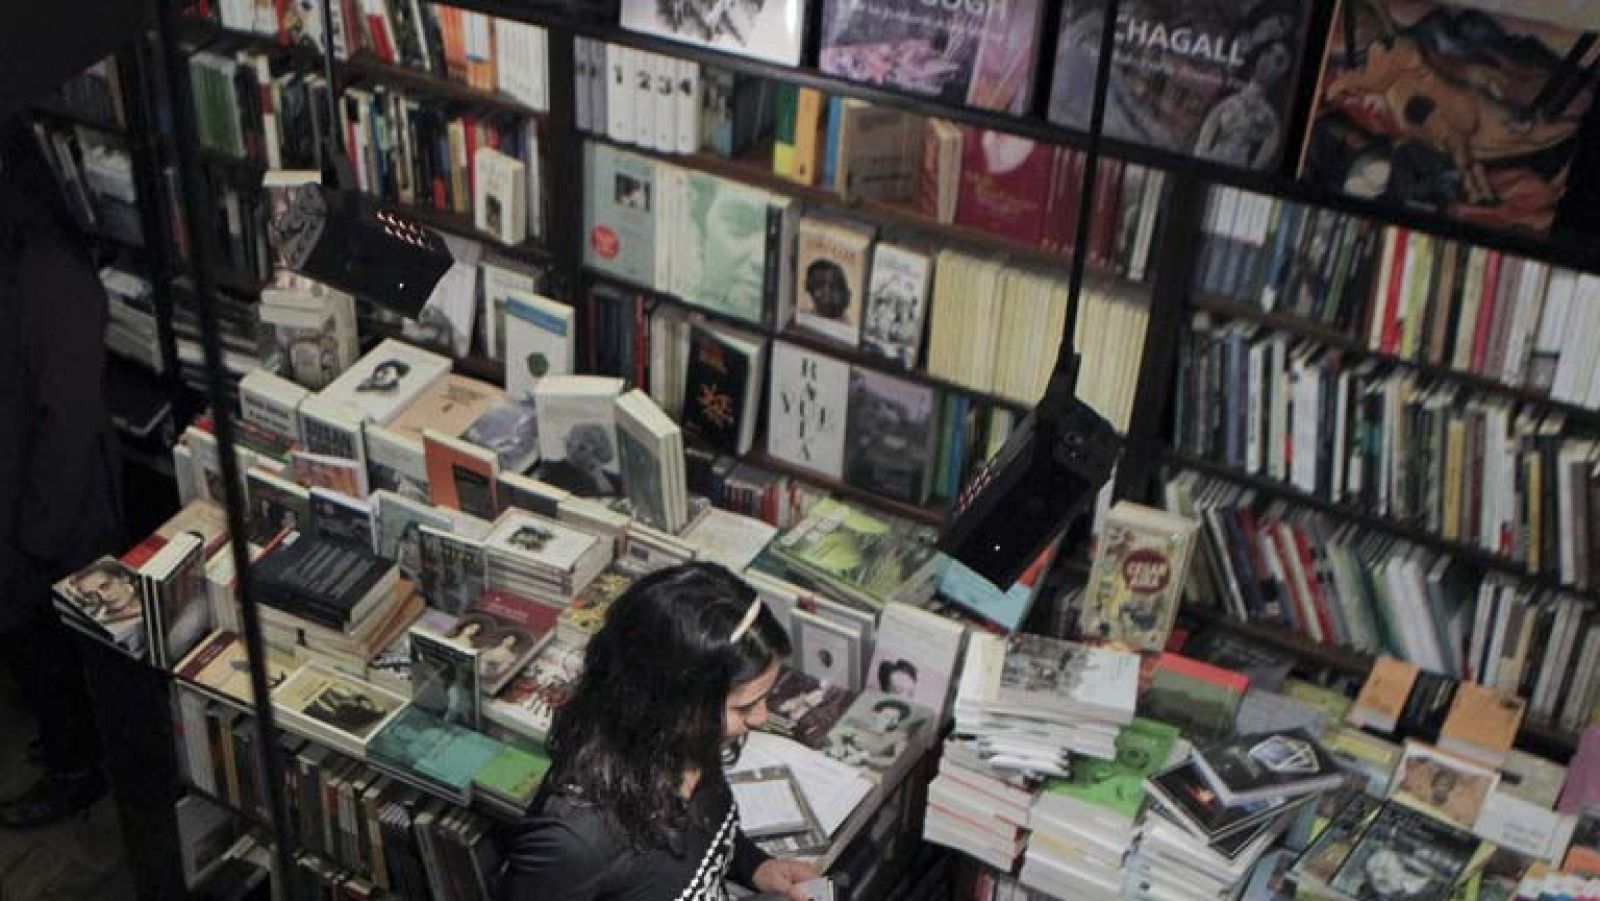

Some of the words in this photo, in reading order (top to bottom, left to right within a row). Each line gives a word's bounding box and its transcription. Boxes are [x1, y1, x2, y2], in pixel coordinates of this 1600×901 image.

[613, 64, 624, 85] 1
[638, 71, 651, 91] 2
[658, 75, 673, 97] 3
